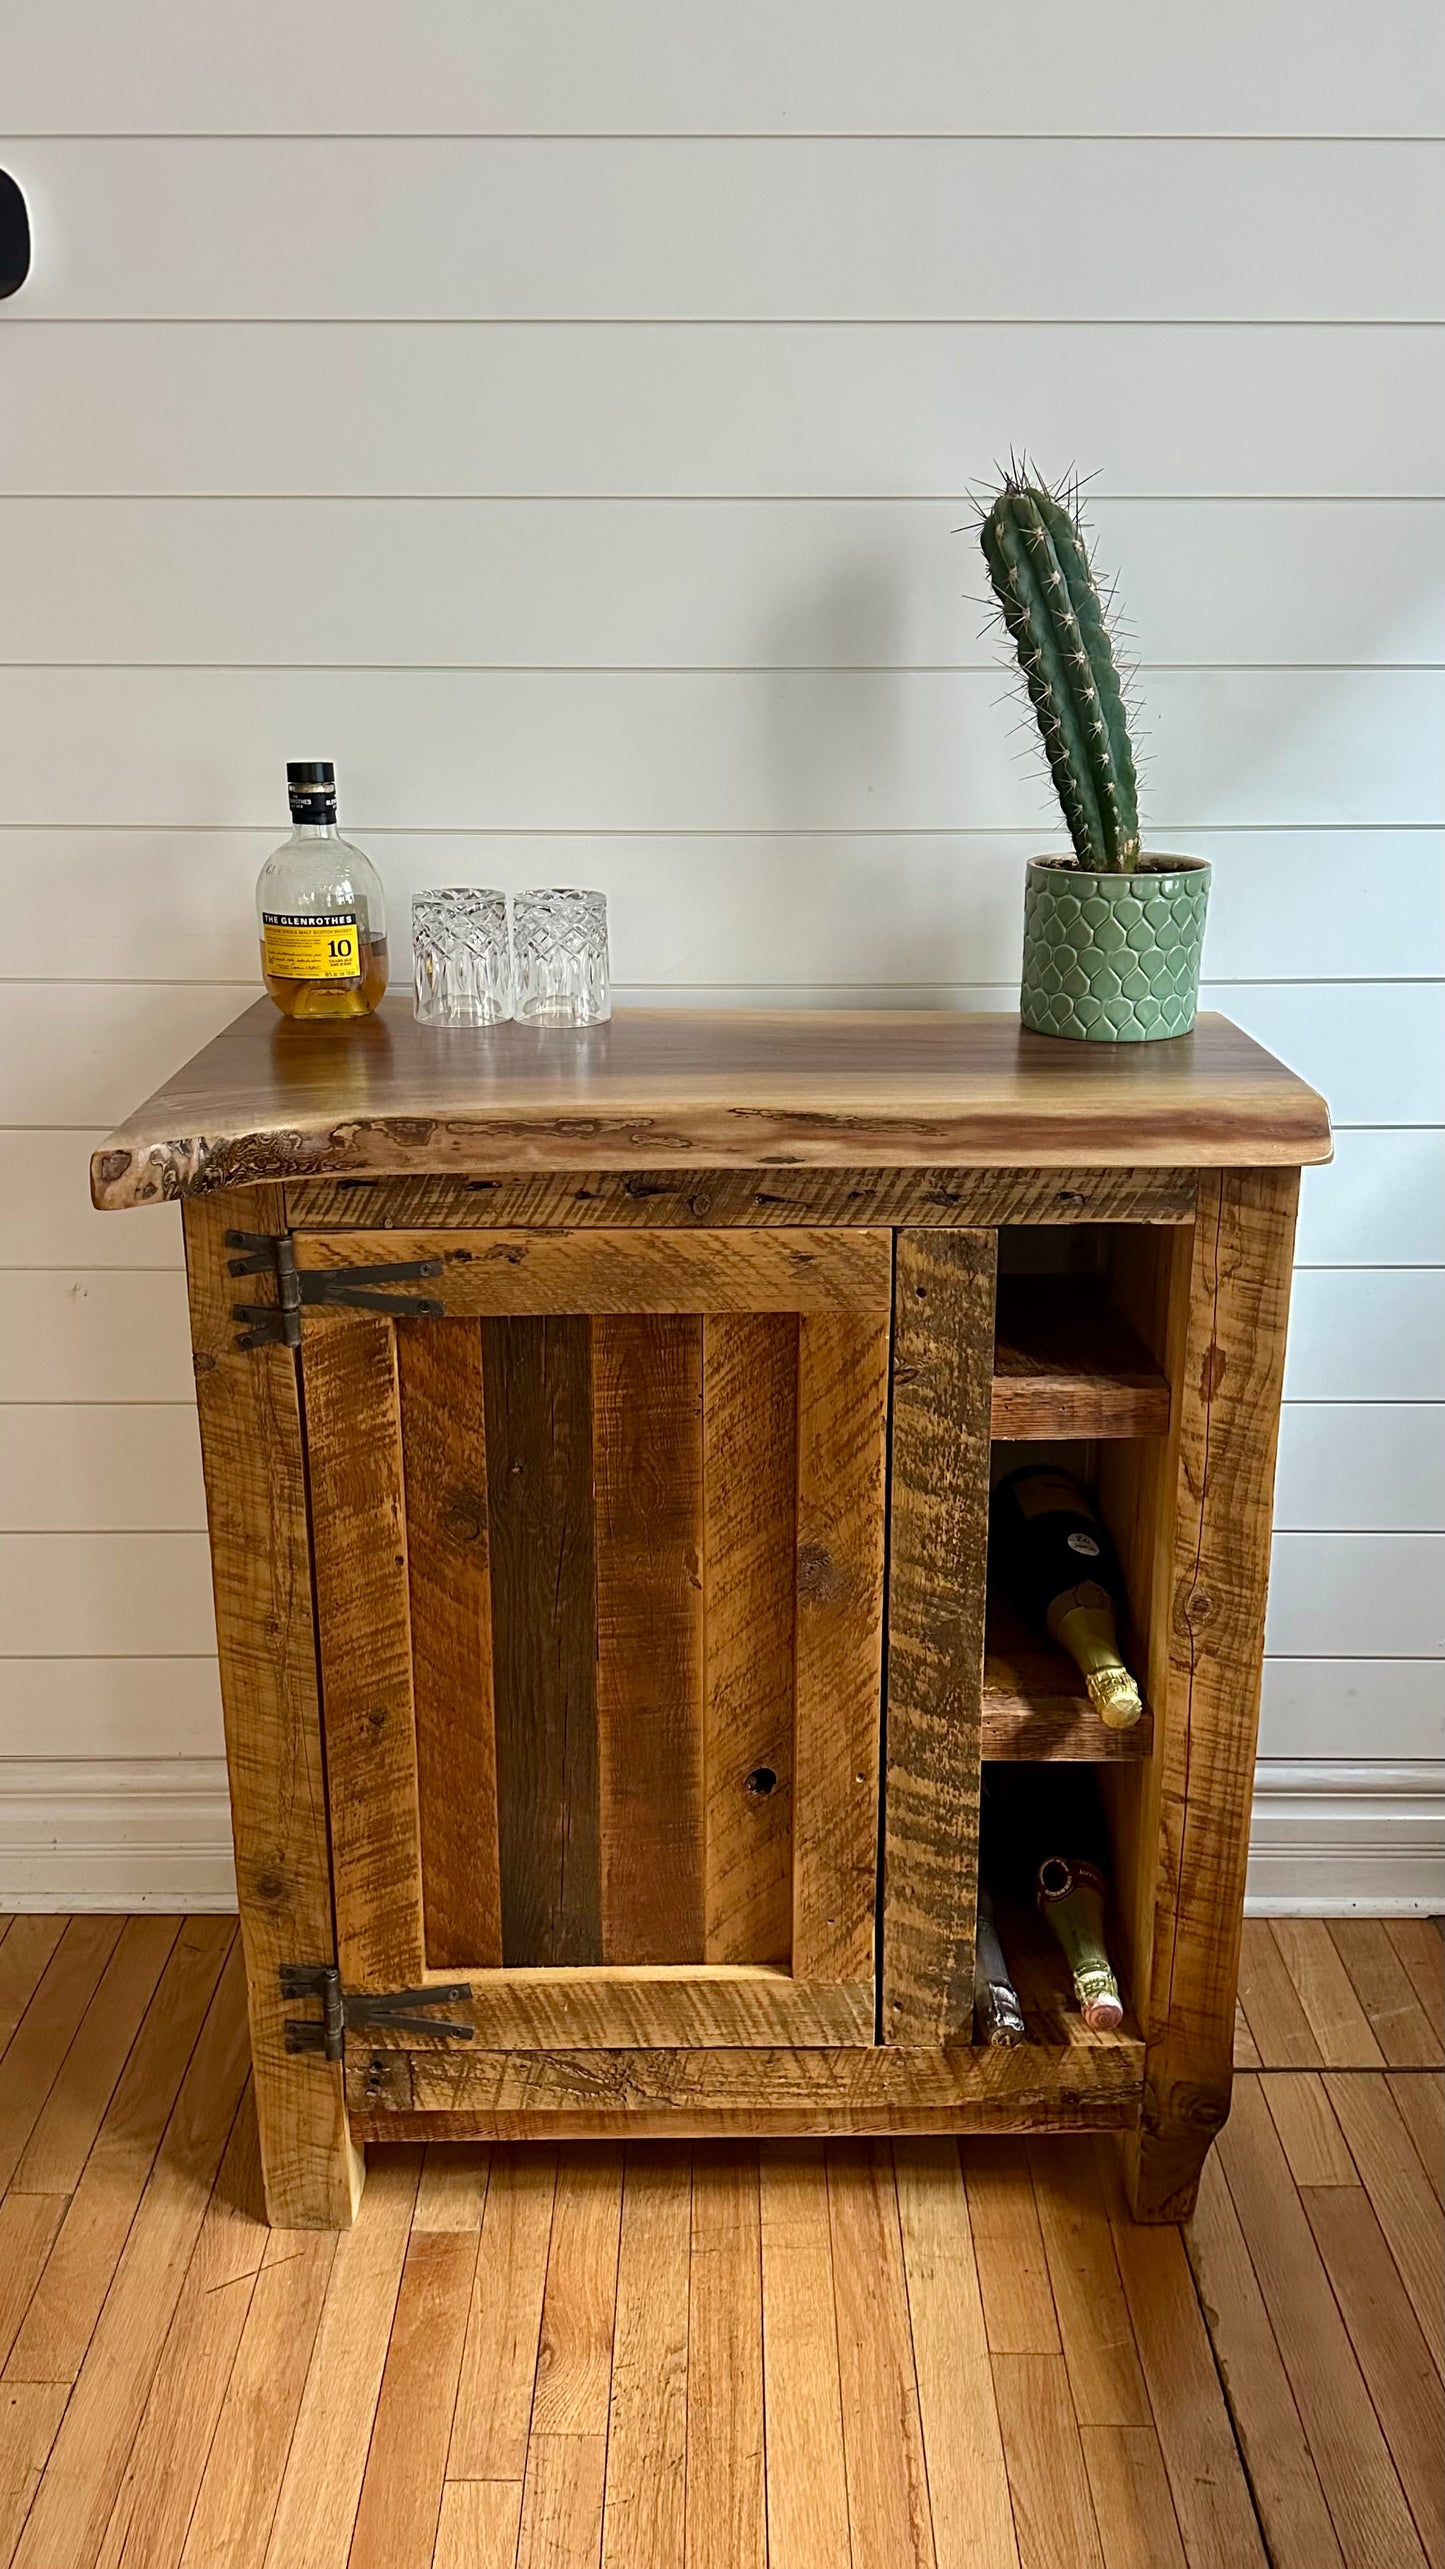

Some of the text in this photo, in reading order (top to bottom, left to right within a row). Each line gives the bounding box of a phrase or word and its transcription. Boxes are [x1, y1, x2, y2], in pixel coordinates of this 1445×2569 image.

[265, 915, 352, 925] THE GLENROTHES
[328, 939, 352, 957] 10
